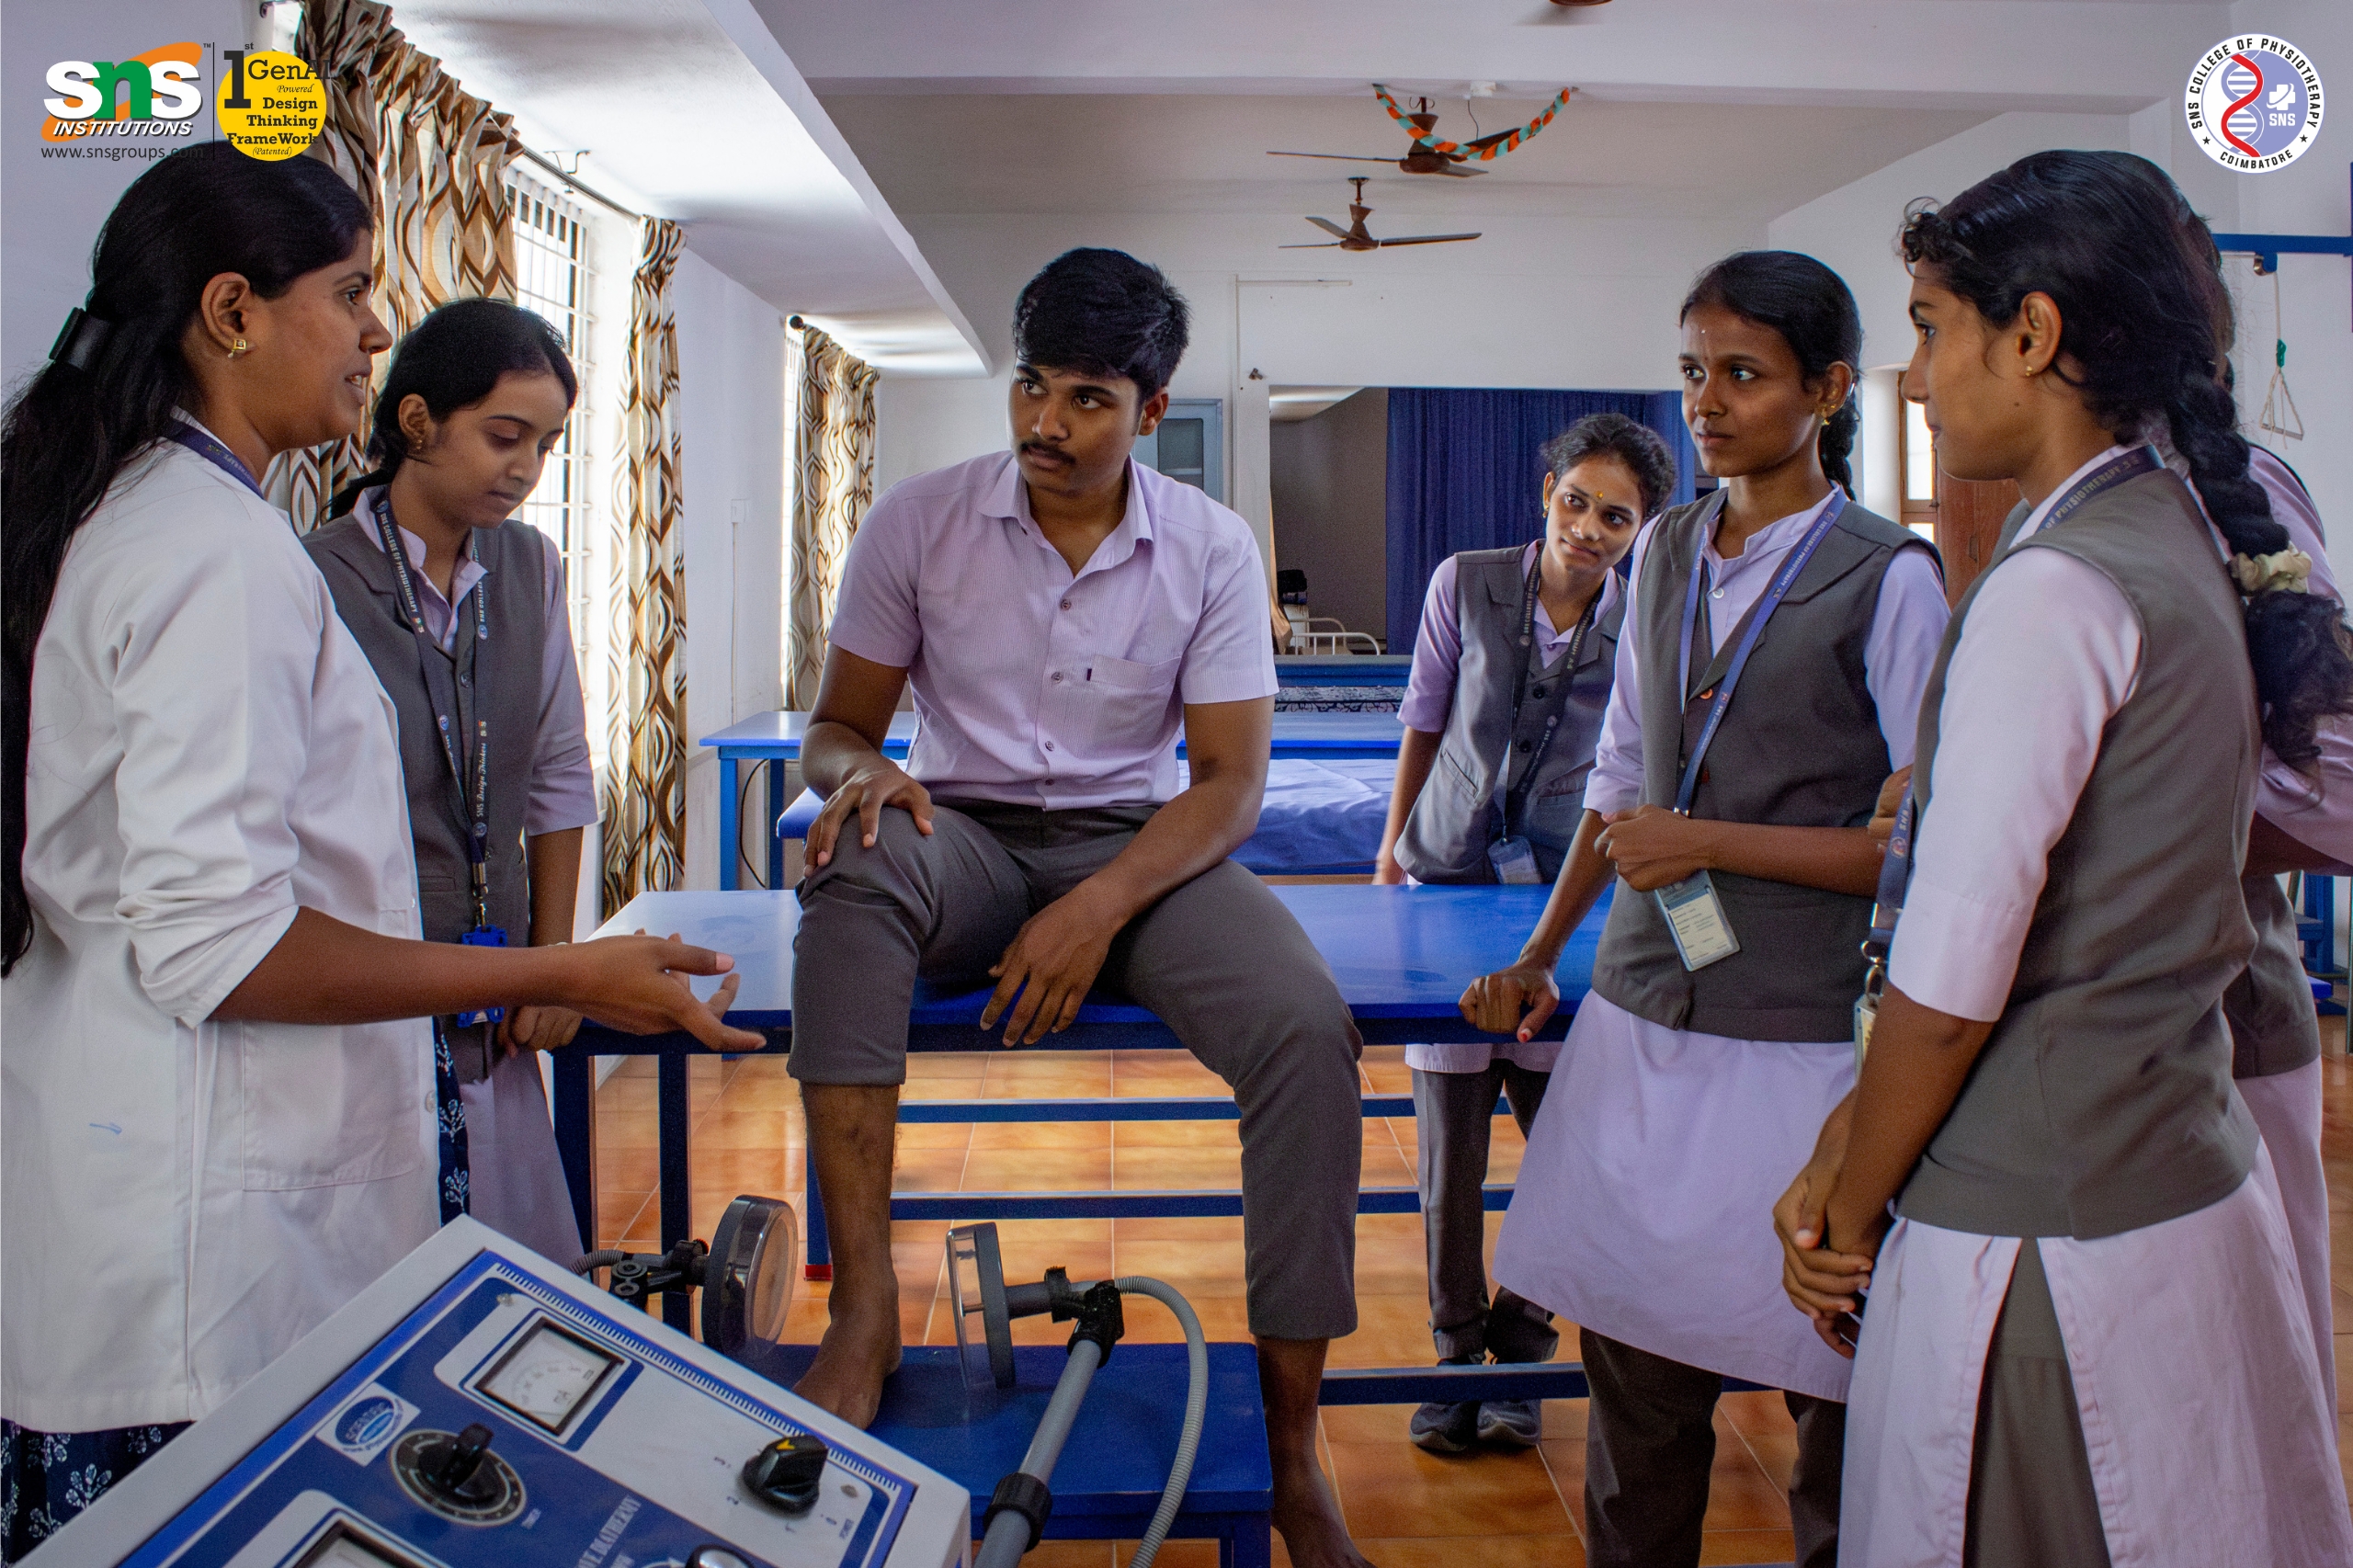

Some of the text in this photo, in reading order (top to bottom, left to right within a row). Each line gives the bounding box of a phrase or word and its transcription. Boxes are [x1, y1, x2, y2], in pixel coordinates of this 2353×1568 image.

[382, 524, 398, 551] COLLEGE
[394, 561, 419, 613] PHYSIOTHERAPY
[475, 802, 483, 817] SNS
